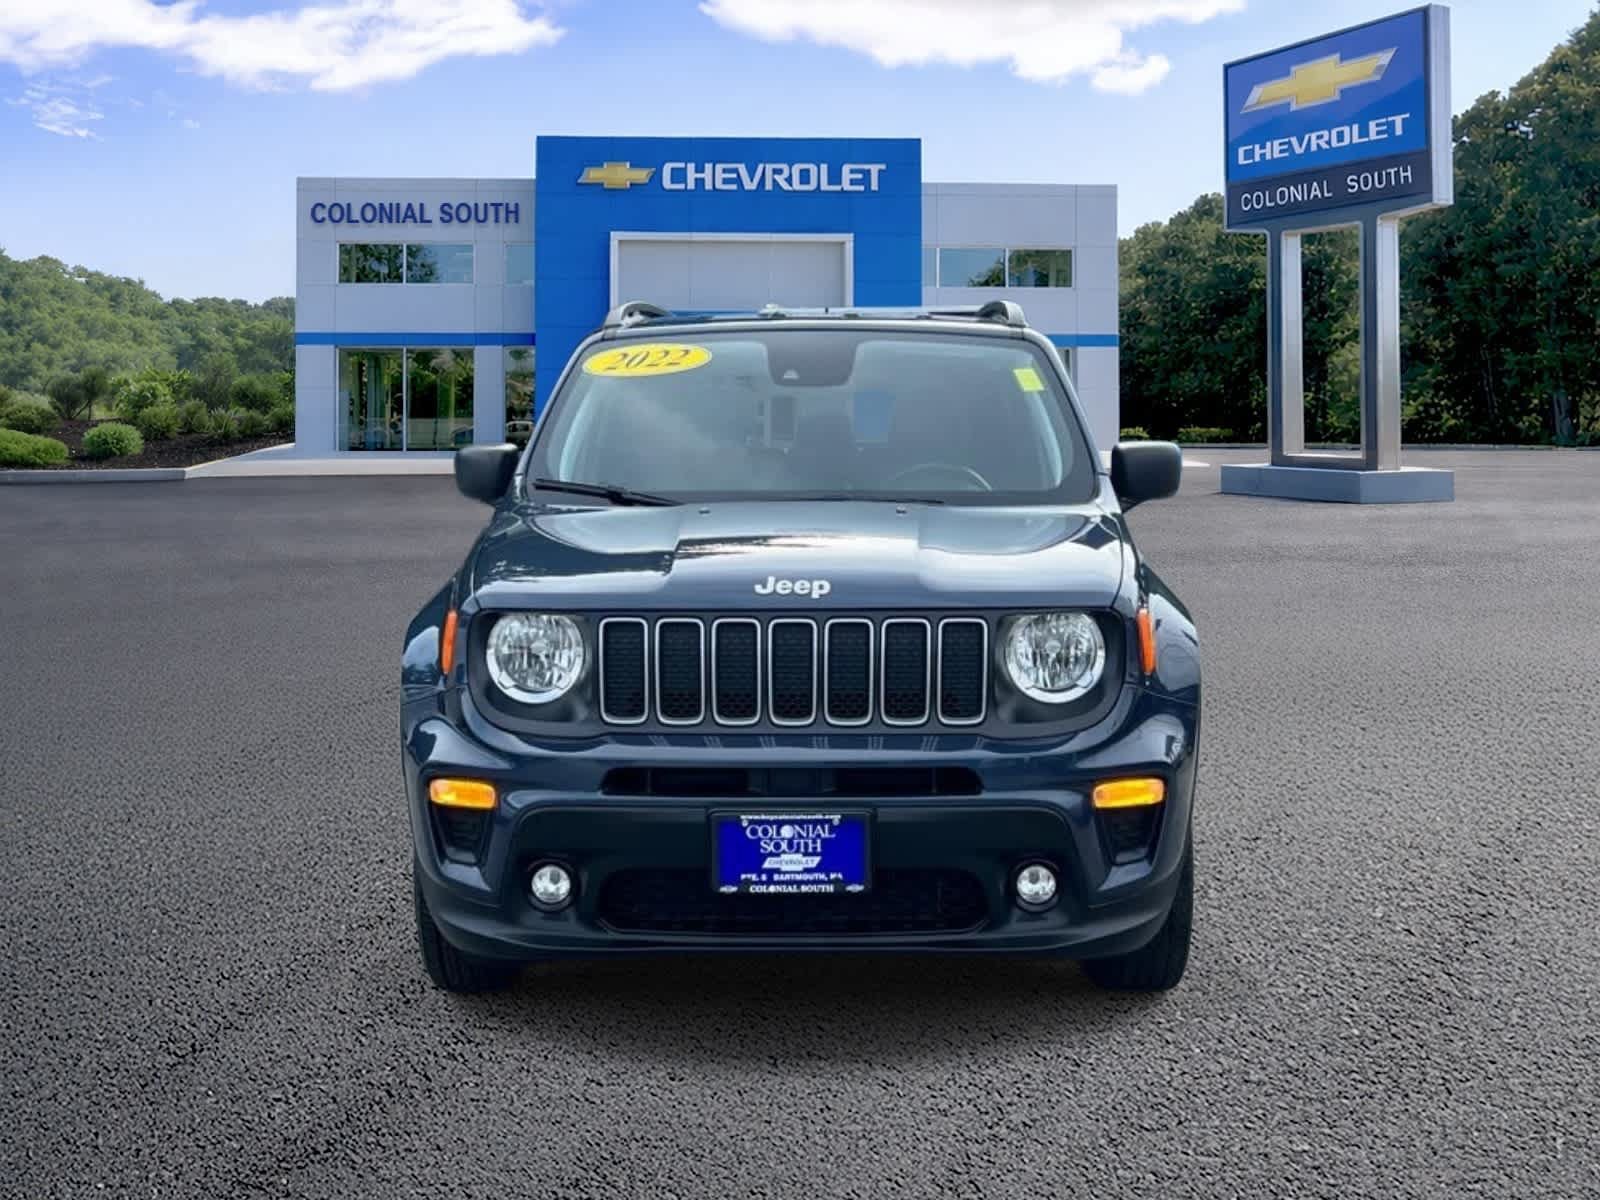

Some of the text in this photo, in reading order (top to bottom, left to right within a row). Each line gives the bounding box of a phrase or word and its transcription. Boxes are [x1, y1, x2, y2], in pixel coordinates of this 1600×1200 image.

[1237, 113, 1410, 165] CHEVROLET
[661, 162, 887, 192] CHEVROLET
[1241, 165, 1413, 211] COLONIAL SOUTH
[311, 202, 520, 225] COLONIAL SOUTH
[603, 349, 692, 371] 2022
[754, 576, 831, 599] Jeep
[745, 825, 837, 839] COLONIAL
[760, 839, 822, 853] SOUTH
[749, 884, 834, 893] COLONIAL SOUTH
